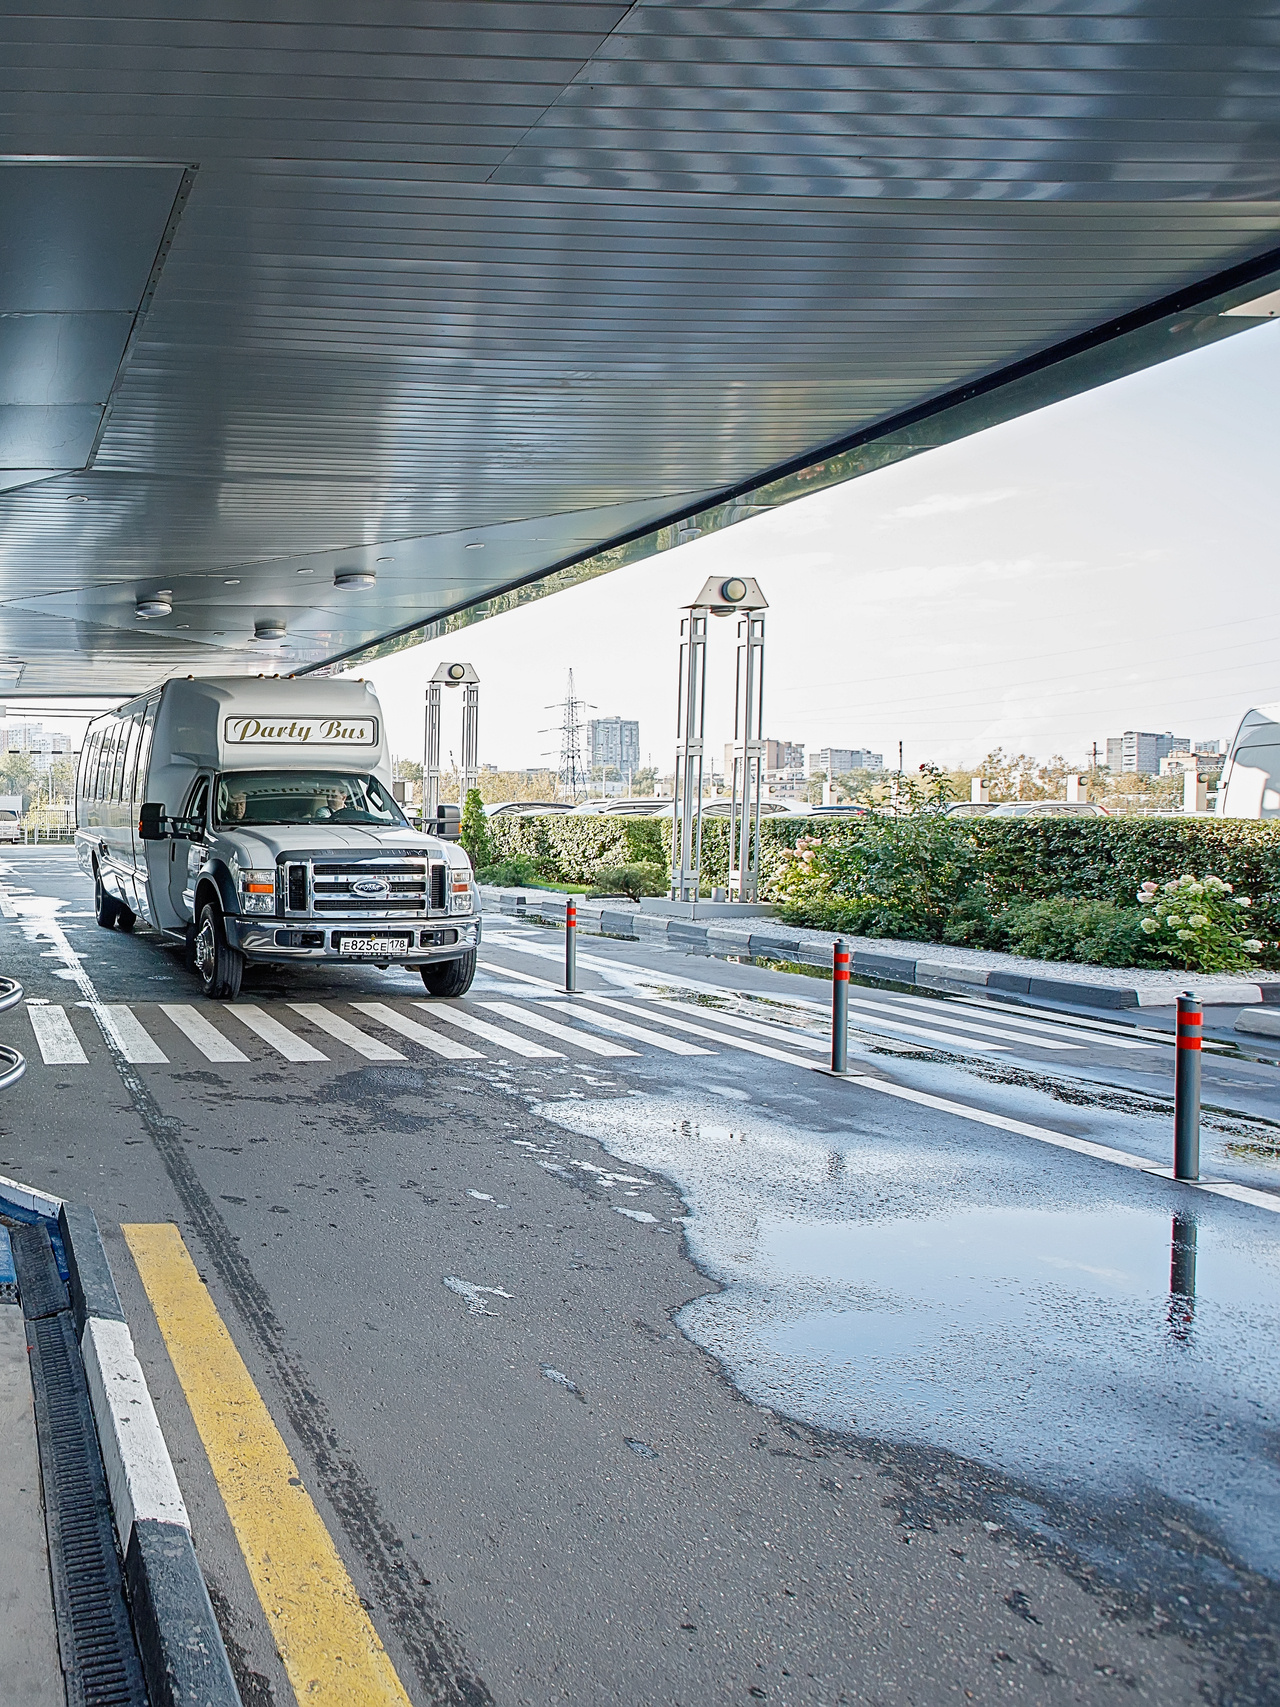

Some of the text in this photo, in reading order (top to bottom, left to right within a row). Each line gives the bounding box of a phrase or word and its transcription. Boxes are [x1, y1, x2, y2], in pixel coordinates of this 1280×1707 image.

[234, 719, 367, 741] Party Bus
[389, 940, 405, 948] 178
